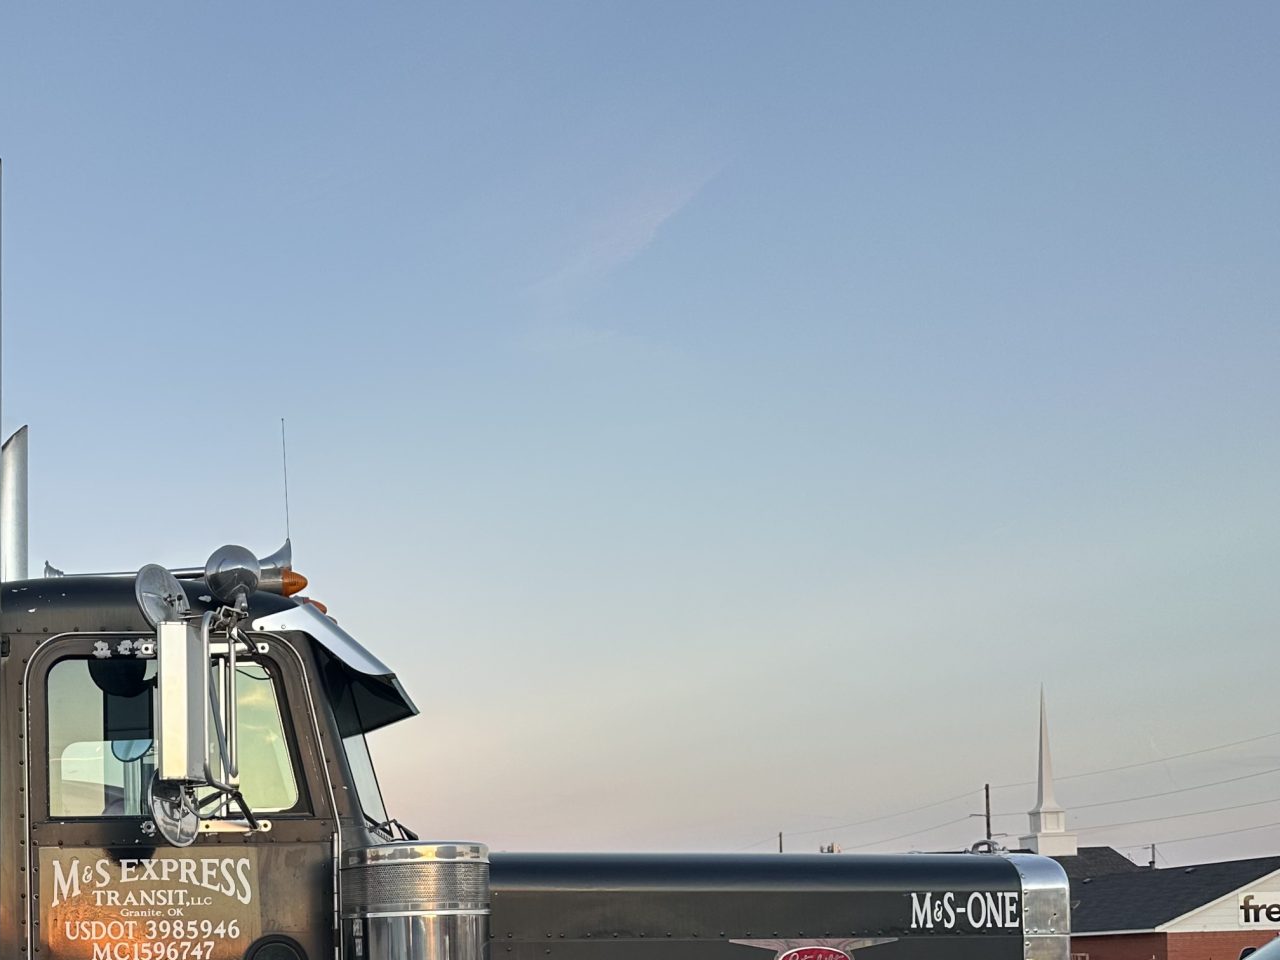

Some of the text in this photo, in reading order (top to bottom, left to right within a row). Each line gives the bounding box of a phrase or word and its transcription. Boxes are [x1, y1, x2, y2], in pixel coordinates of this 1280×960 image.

[51, 857, 252, 908] M&S EXPRESS
[167, 908, 184, 917] OK
[910, 891, 1020, 928] M&S-ONE
[65, 919, 240, 940] USDOT 3985946
[92, 941, 215, 960] MC1596747
